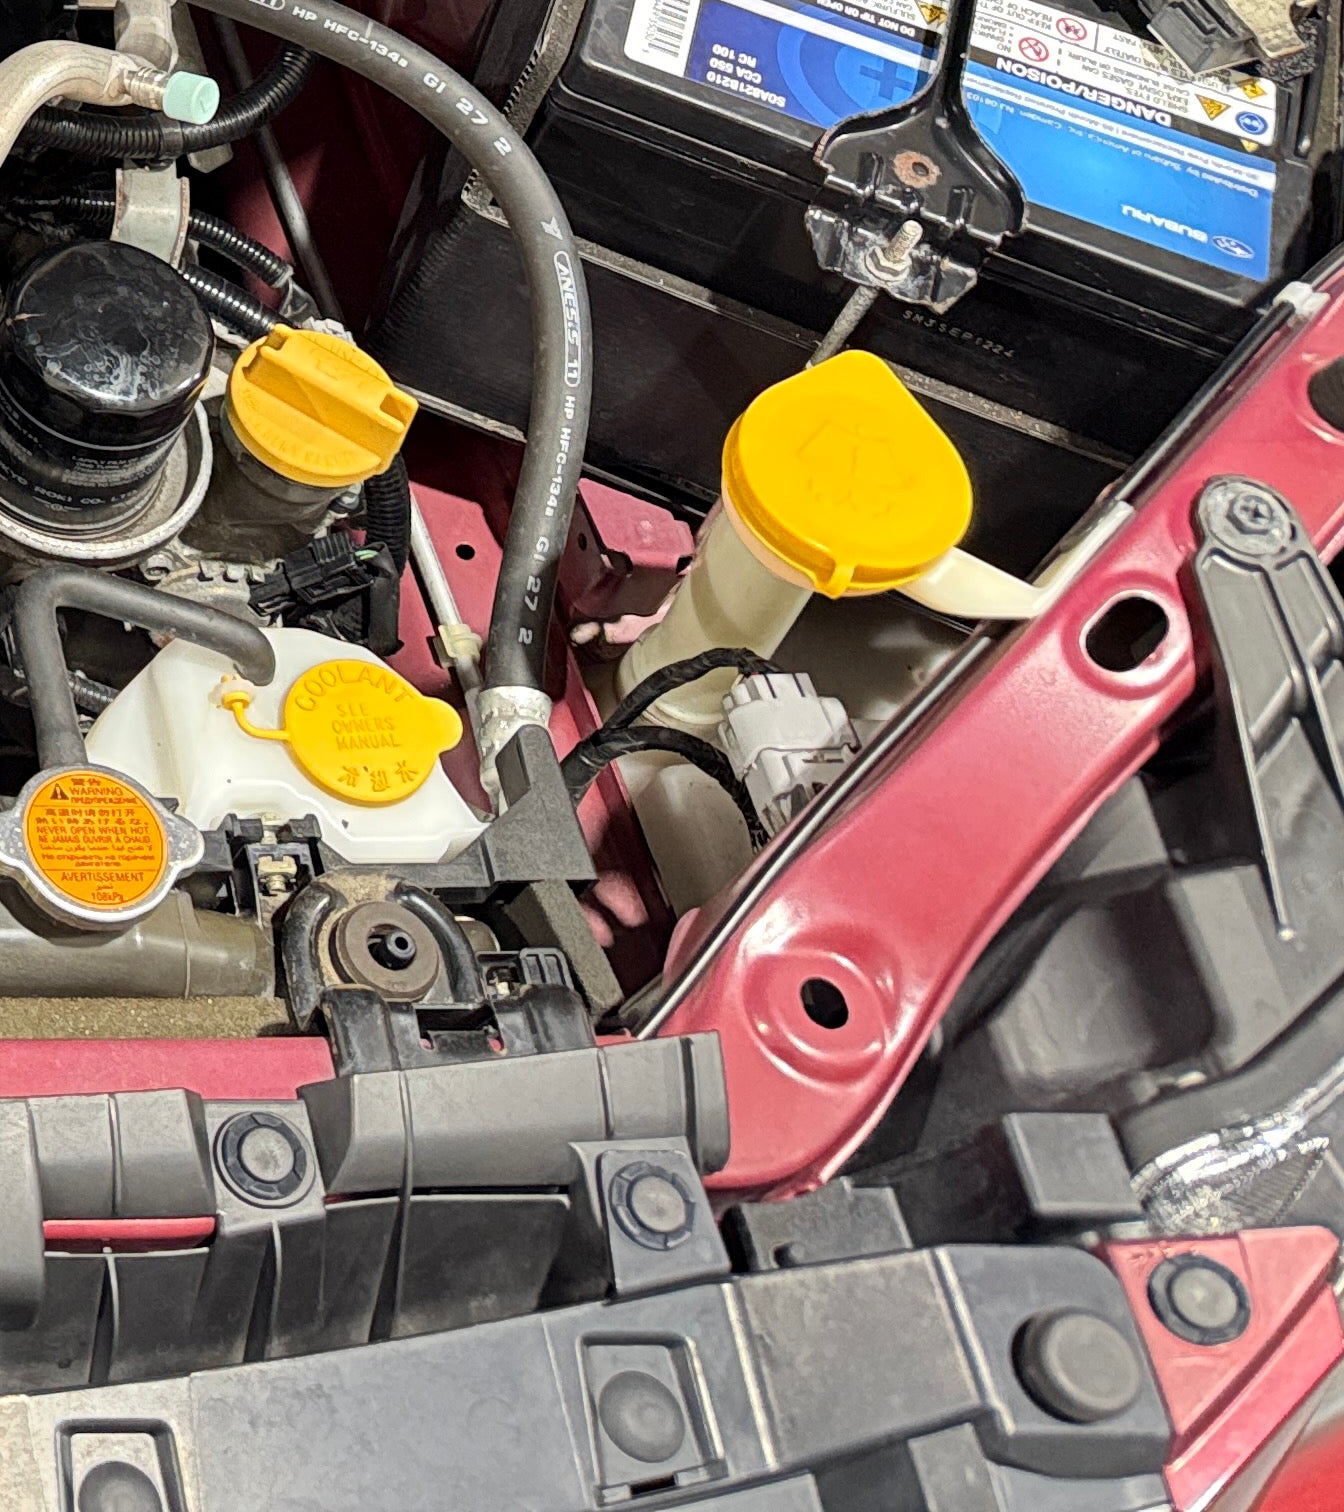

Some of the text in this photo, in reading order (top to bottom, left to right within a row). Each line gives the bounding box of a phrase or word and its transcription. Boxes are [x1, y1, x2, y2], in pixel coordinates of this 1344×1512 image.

[843, 4, 859, 17] OR
[990, 3, 1004, 13] OF
[1005, 0, 1019, 10] OF
[859, 10, 876, 23] TIP
[1005, 8, 1023, 19] OUT
[877, 16, 899, 31] NOT
[898, 23, 916, 37] DO
[1025, 15, 1053, 30] KEEP
[711, 43, 757, 67] RC 100
[995, 42, 1011, 53] NO
[708, 56, 763, 83] CCA 550
[291, 4, 318, 25] HP
[456, 97, 489, 126] 27
[496, 136, 513, 157] 2
[994, 55, 1174, 127] DANGER/POISON
[1118, 203, 1209, 243] SUBARU
[563, 395, 574, 419] HP
[525, 574, 541, 618] 27
[295, 664, 412, 712] COOLANT
[336, 703, 368, 717] SEE
[331, 717, 396, 734] OWNERS
[336, 734, 401, 751] MANUAL
[69, 787, 123, 796] WARNING
[36, 826, 66, 834] NEVER
[71, 826, 95, 834] OPEN
[99, 826, 127, 834] WHEN
[62, 872, 144, 882] AVERTISSEMENT
